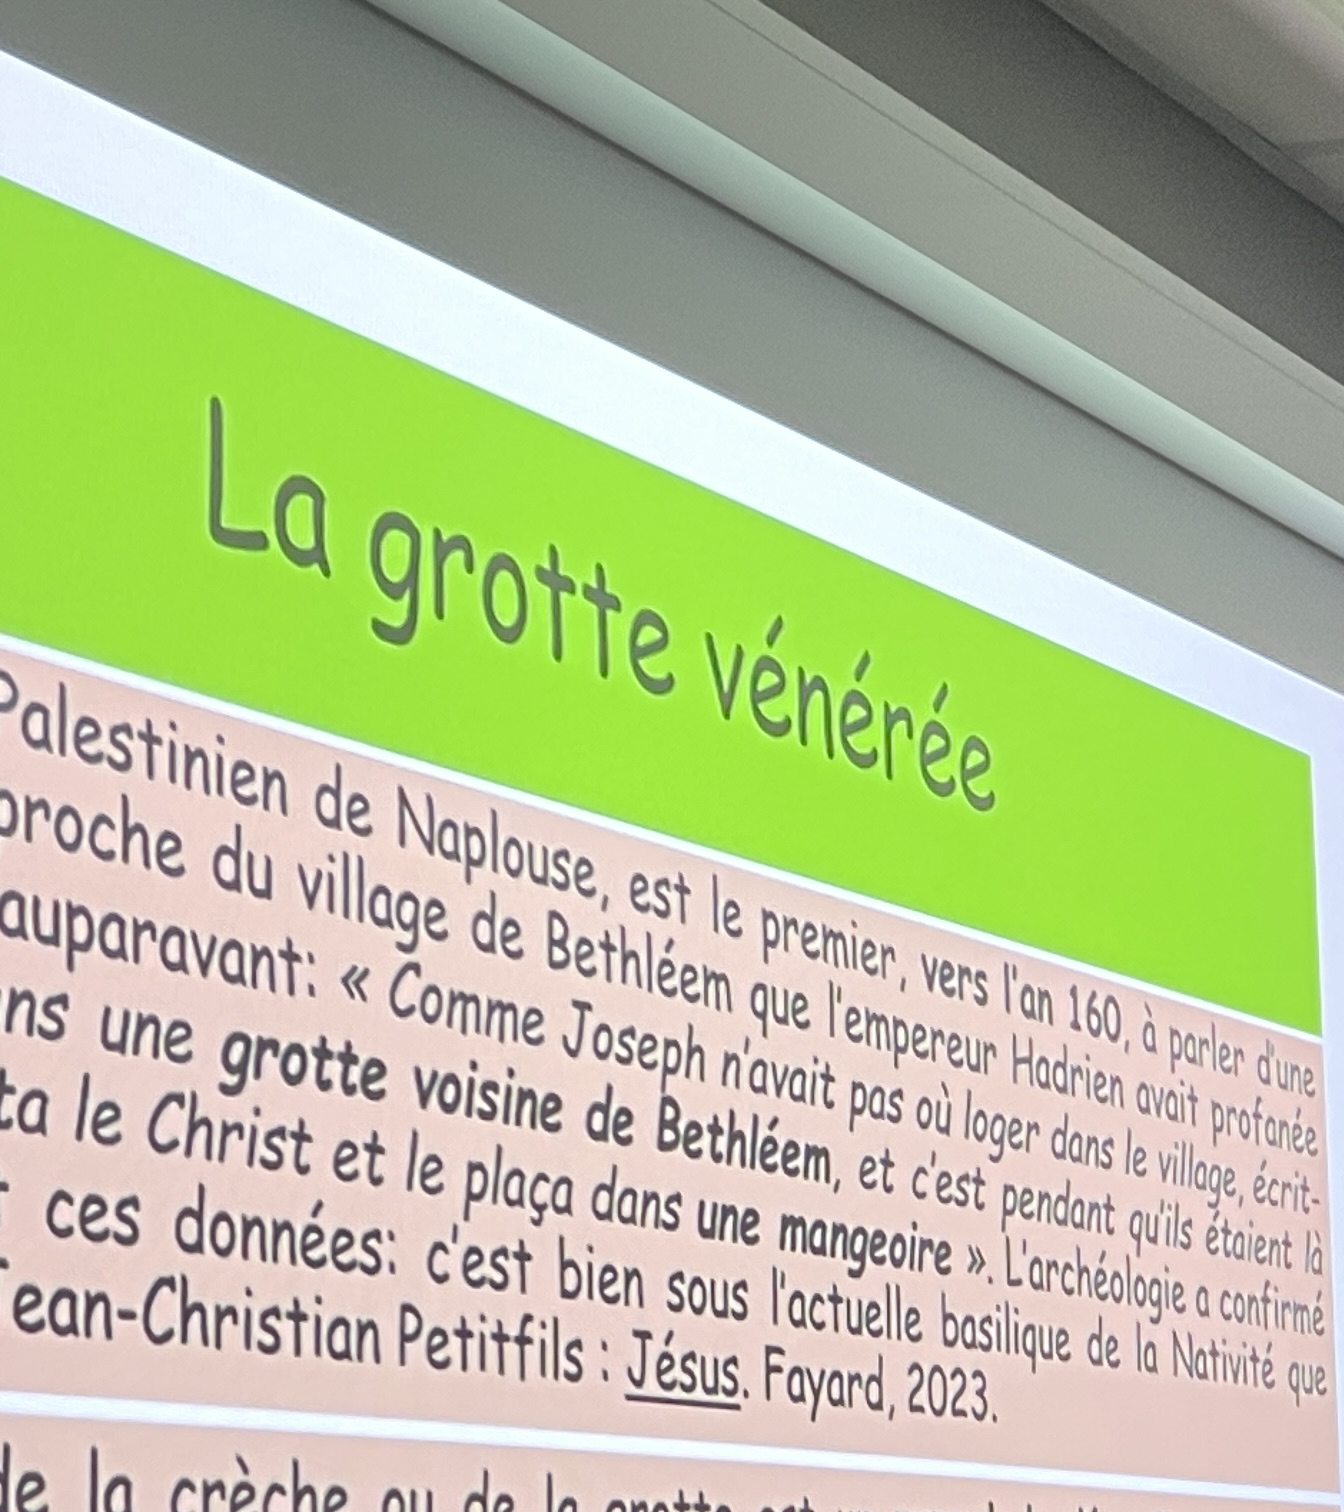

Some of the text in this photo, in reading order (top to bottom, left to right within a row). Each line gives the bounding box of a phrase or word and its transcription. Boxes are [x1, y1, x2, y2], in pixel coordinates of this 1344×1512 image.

[208, 396, 996, 812] La grotte vénérée
[0, 888, 317, 998] auparavant:
[388, 960, 546, 1047] Comme
[561, 998, 706, 1095] Joseph
[720, 1035, 837, 1110] n'avait
[848, 1079, 905, 1134] pas
[915, 1080, 953, 1138] où
[963, 1088, 1041, 1164] loger
[1050, 1112, 1115, 1171] dans
[1124, 1126, 1148, 1178] le
[212, 822, 273, 902] du
[297, 850, 450, 955] village
[470, 889, 525, 961] de
[546, 909, 734, 1015] Bethléem
[749, 981, 812, 1040] que
[828, 979, 998, 1076] l'empereur
[1012, 1032, 1125, 1110] Hadrien
[1135, 1079, 1199, 1128] avait
[1210, 1095, 1319, 1157] profanée
[314, 761, 374, 838] de
[397, 784, 610, 913] Naplouse,
[629, 871, 692, 926] est
[711, 873, 744, 939] le
[760, 906, 907, 993] premier,
[920, 952, 989, 1007] vers
[1003, 961, 1054, 1027] l'an
[1069, 984, 1130, 1055] 160,
[1168, 1023, 1245, 1077] parler
[1257, 1039, 1316, 1098] d'une
[74, 1071, 1325, 1337] le Christ et le plaça dans une mangeoire L'archéologie confirmé
[99, 1004, 1293, 1270] une grotte voisine de Bethléem, et c'est pendant qu'ils étaient
[45, 1181, 1328, 1408] ces données: c'est bien sous l'actuelle basilique de la Nativité que
[398, 1301, 584, 1384] Petitfils
[626, 1327, 750, 1400] Jésus.
[763, 1343, 896, 1424] Fayard,
[906, 1360, 998, 1424] 2023.
